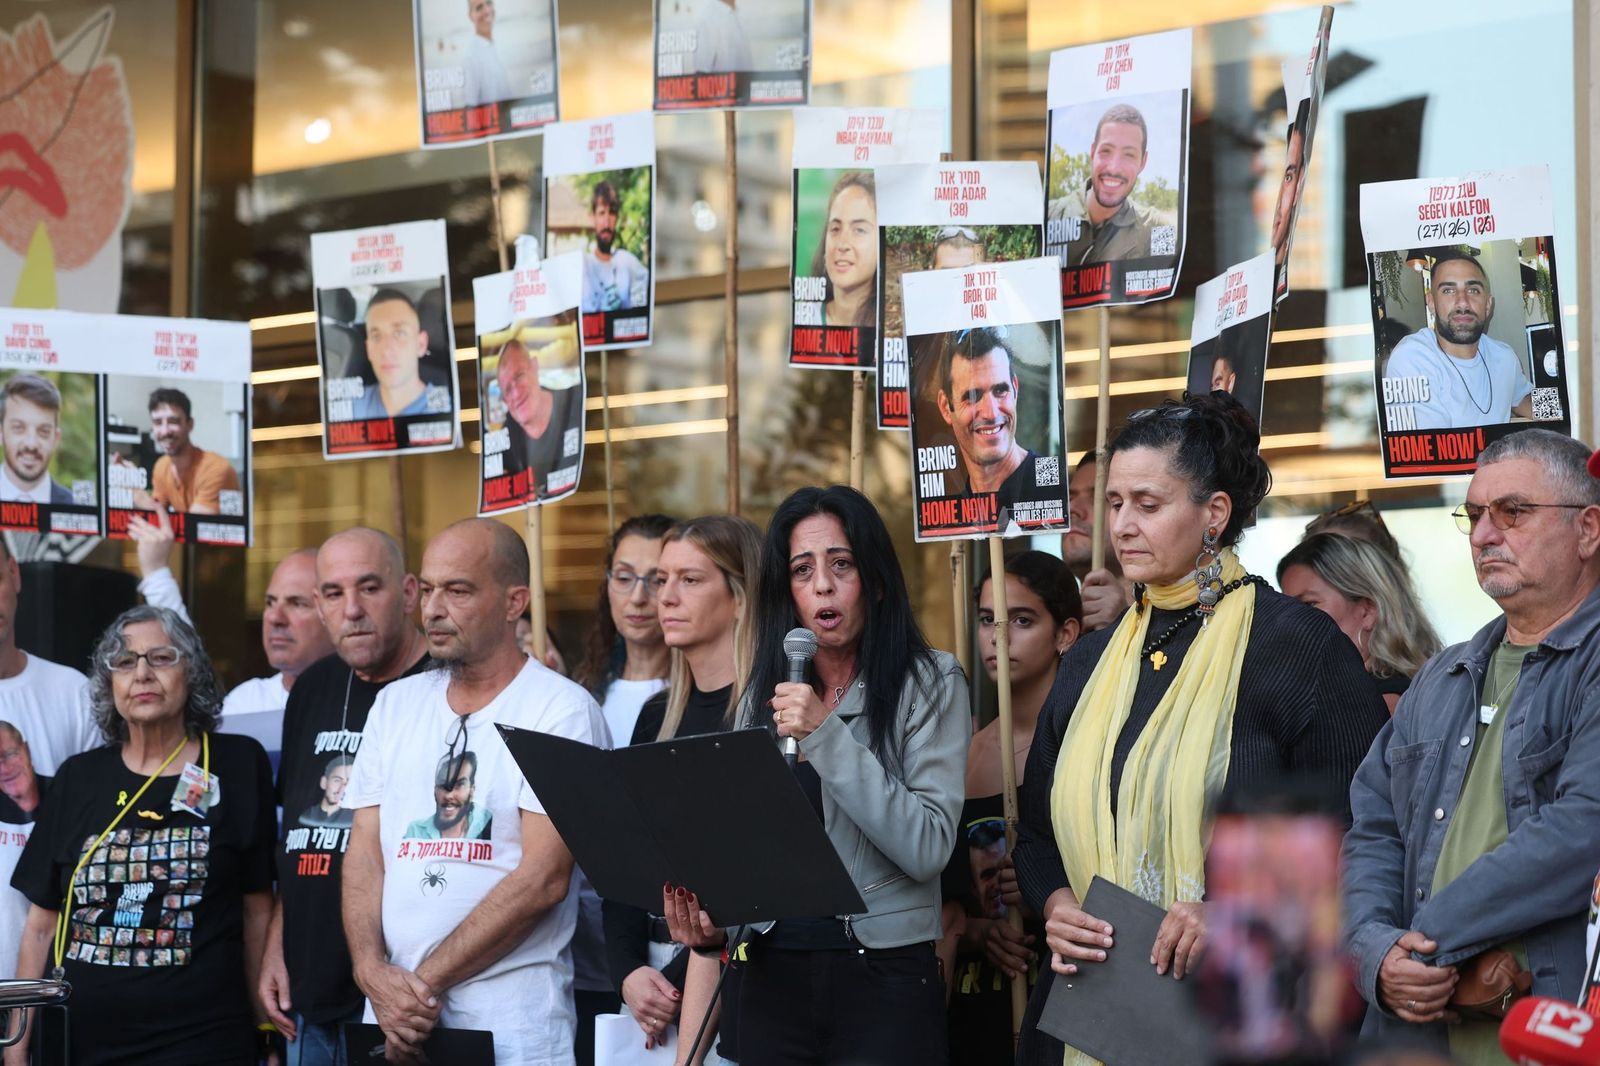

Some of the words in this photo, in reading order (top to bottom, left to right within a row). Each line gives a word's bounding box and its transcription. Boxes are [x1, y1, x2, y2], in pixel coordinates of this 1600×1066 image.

[658, 32, 696, 54] BRING
[658, 53, 683, 76] HIM
[1097, 62, 1114, 76] ITAY
[1114, 58, 1133, 74] CHEN
[426, 67, 465, 89] BRING
[659, 78, 695, 101] HOME
[698, 72, 736, 99] NOW!
[1106, 75, 1120, 92] (19)
[428, 111, 464, 136] HOME
[836, 131, 858, 145] INBAR
[859, 131, 893, 145] HAYMAN
[854, 146, 869, 161] (27)
[939, 170, 956, 185] אדר
[957, 170, 980, 185] תמיר
[934, 186, 959, 201] TAMIR
[961, 186, 987, 201] ADAR
[1429, 186, 1455, 204] כלפון
[1456, 182, 1477, 200] שגב
[949, 202, 969, 218] (38)
[1418, 203, 1447, 221] SEGEV
[1450, 198, 1491, 218] KALFON
[1048, 217, 1082, 244] BRING
[794, 277, 827, 302] BRING
[963, 273, 975, 289] אור
[977, 271, 997, 286] דרור
[1062, 271, 1077, 295] ME
[1080, 263, 1111, 293] NOW!
[963, 289, 983, 304] DROR
[985, 287, 997, 302] OR
[795, 302, 815, 327] HER
[971, 304, 987, 320] (48)
[793, 328, 823, 353] HOME
[826, 327, 859, 355] NOW!
[327, 376, 364, 402] BRING
[1382, 376, 1430, 404] BRING
[883, 391, 909, 415] HO
[1385, 405, 1417, 432] HIM
[329, 422, 366, 446] HOME
[1388, 435, 1434, 463] HOME
[1436, 428, 1485, 461] NOW!
[918, 445, 957, 472] BRING
[108, 465, 148, 489] BRING
[919, 472, 946, 498] HIM
[484, 475, 512, 503] HOME
[2, 502, 38, 525] NOW!
[921, 500, 959, 526] HOME
[961, 493, 998, 522] NOW!
[1013, 501, 1035, 511] HOSTAGES
[1044, 499, 1063, 509] MISSING
[1014, 509, 1041, 522] FAMILIES
[1041, 508, 1064, 521] FORUM
[311, 826, 341, 850] שלי
[468, 842, 493, 862] מתן
[298, 854, 331, 876] בעזה
[114, 911, 143, 928] NOW
